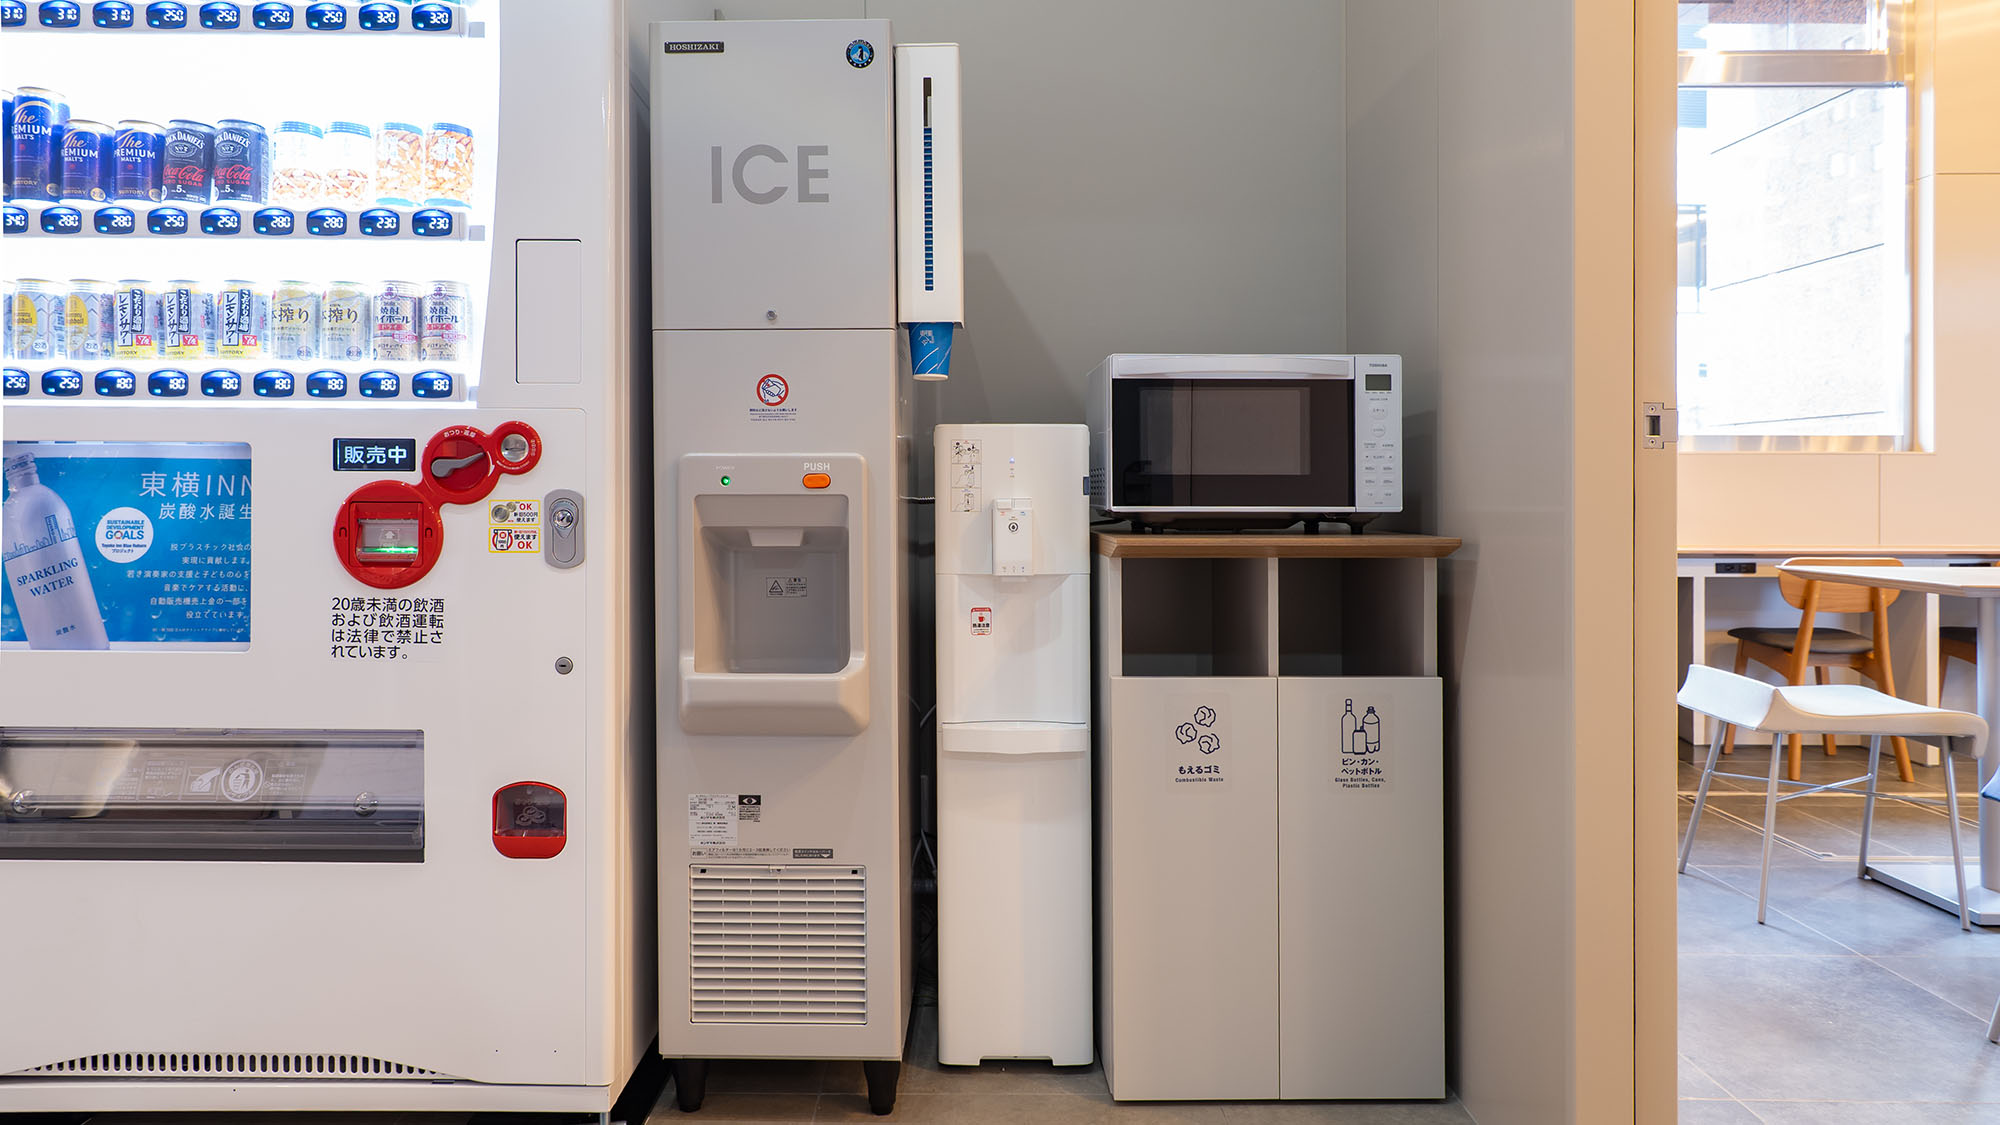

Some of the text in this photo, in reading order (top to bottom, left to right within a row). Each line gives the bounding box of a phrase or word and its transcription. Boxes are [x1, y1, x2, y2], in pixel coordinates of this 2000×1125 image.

[3, 8, 24, 20] 310
[57, 8, 77, 21] 310
[111, 8, 131, 21] 310
[163, 8, 184, 22] 250
[216, 9, 237, 22] 250
[270, 11, 290, 23] 250
[323, 11, 343, 23] 250
[377, 11, 396, 23] 320
[430, 12, 449, 24] 320
[669, 43, 720, 51] HOSHIZAKI
[13, 107, 39, 124] The
[63, 133, 87, 149] The
[120, 134, 145, 149] The
[176, 130, 206, 150] DANIEL'S
[223, 130, 252, 149] DANIEL'S
[711, 144, 830, 205] ICE
[6, 215, 25, 227] 340
[58, 215, 79, 227] 280
[111, 215, 132, 228] 280
[164, 215, 185, 228] 250
[217, 216, 238, 228] 250
[270, 216, 291, 228] 280
[323, 217, 344, 229] 280
[376, 217, 397, 229] 230
[429, 217, 449, 230] 230
[119, 294, 131, 344] レモンサワー
[166, 294, 178, 344] レモンサワー
[225, 294, 238, 344] レモンサワー
[5, 377, 27, 389] 250
[59, 377, 80, 389] 250
[116, 378, 133, 390] 180
[169, 378, 185, 390] 180
[222, 378, 239, 390] 180
[275, 378, 291, 391] 180
[328, 378, 344, 391] 180
[380, 379, 397, 391] 180
[433, 379, 450, 391] 180
[344, 446, 408, 465] 販売中
[803, 462, 831, 471] PUSH
[138, 471, 252, 498] 東横INN
[158, 502, 252, 521] 炭酸水誕生
[519, 503, 533, 511] OK
[105, 530, 145, 540] GOALS
[170, 543, 252, 552] 脱プラスチック社会の
[517, 541, 533, 550] OK
[16, 556, 80, 587] SPARKLING
[29, 574, 76, 598] WATER
[331, 597, 445, 613] 20歳未満の飲酒
[331, 613, 445, 629] および飲酒運転
[331, 628, 444, 644] は法律で禁止さ
[331, 644, 408, 660] れています。
[1342, 758, 1380, 766] ビン・カン・
[1178, 765, 1220, 775] もえるゴミ
[1341, 767, 1383, 776] ペットボトル
